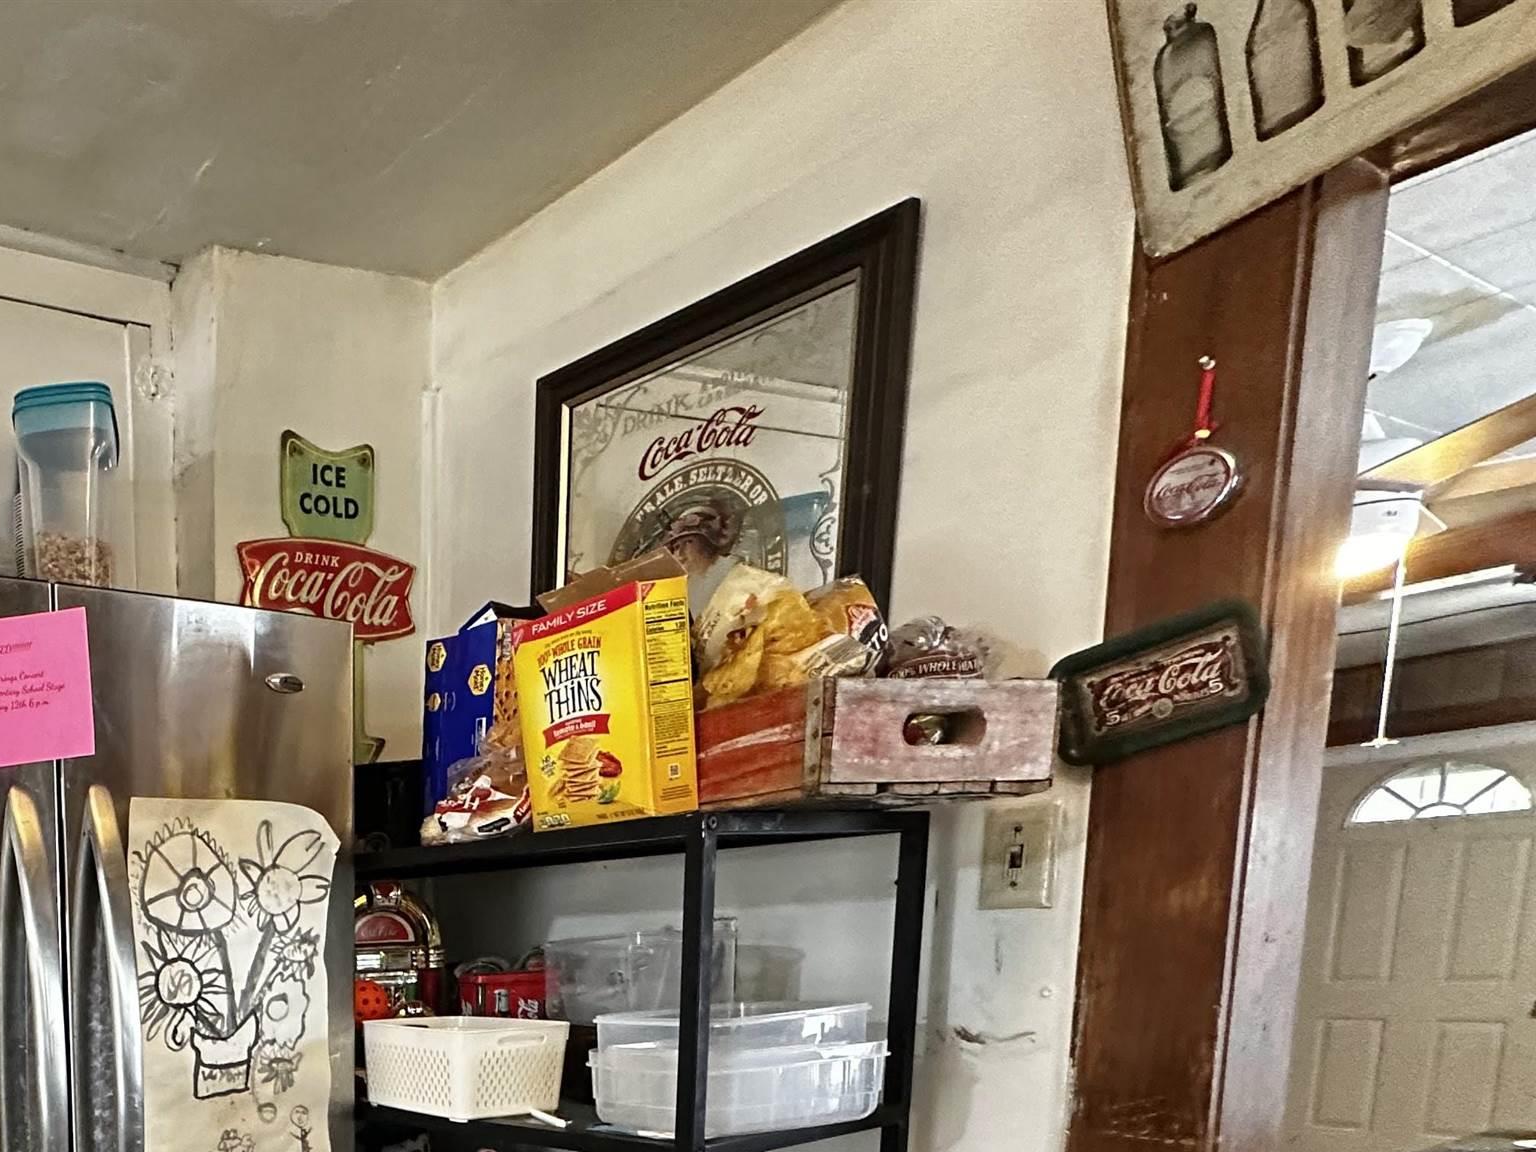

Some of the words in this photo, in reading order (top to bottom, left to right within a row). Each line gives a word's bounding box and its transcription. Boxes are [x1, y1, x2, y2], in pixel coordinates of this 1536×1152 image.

[638, 404, 766, 482] Coca-Cola
[311, 463, 347, 488] ICE
[688, 463, 752, 493] SELTZER
[298, 491, 360, 520] COLD
[294, 551, 341, 568] DRINK
[252, 551, 410, 627] Coca-Cola
[530, 608, 576, 636] FAMILY
[574, 598, 608, 619] SIZE
[576, 635, 603, 651] GRAIN
[539, 649, 602, 691] WHEAT
[918, 659, 957, 675] WHOLE
[1099, 644, 1224, 706] Coca-Cola
